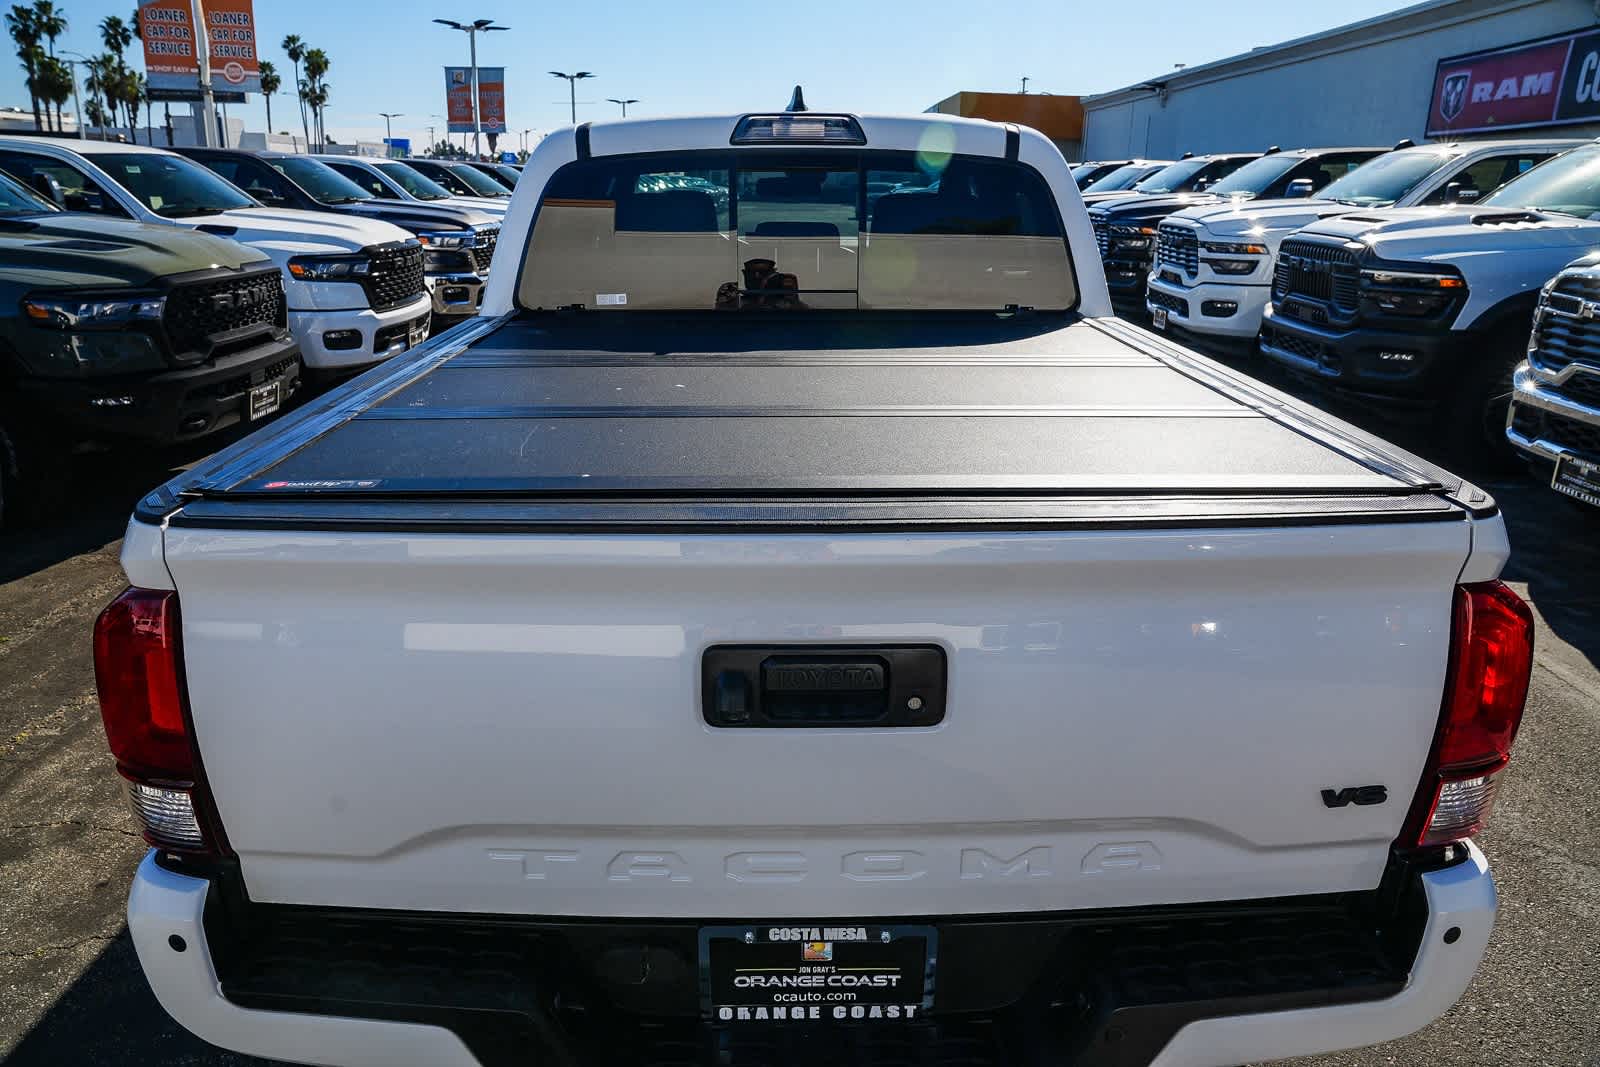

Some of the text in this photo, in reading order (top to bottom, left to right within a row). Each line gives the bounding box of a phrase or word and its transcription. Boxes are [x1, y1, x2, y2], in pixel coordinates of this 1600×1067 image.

[144, 8, 187, 22] LOANER
[208, 12, 250, 25] LOANER
[145, 25, 191, 39] CAR FOR
[210, 29, 253, 41] CAR FOR
[148, 41, 191, 56] SERVICE
[213, 45, 254, 58] SERVICE
[1576, 51, 1600, 103] C
[1471, 72, 1555, 104] RAM
[774, 666, 882, 690] TOYOTA
[1320, 785, 1388, 808] V6
[486, 840, 1165, 884] TACOMA
[768, 927, 868, 941] COSTA MESA
[812, 965, 836, 973] GRAY'S
[734, 975, 901, 988] ORANGE COAST
[773, 991, 857, 1002] ocauto.com
[719, 1005, 917, 1020] ORANGE COAST
